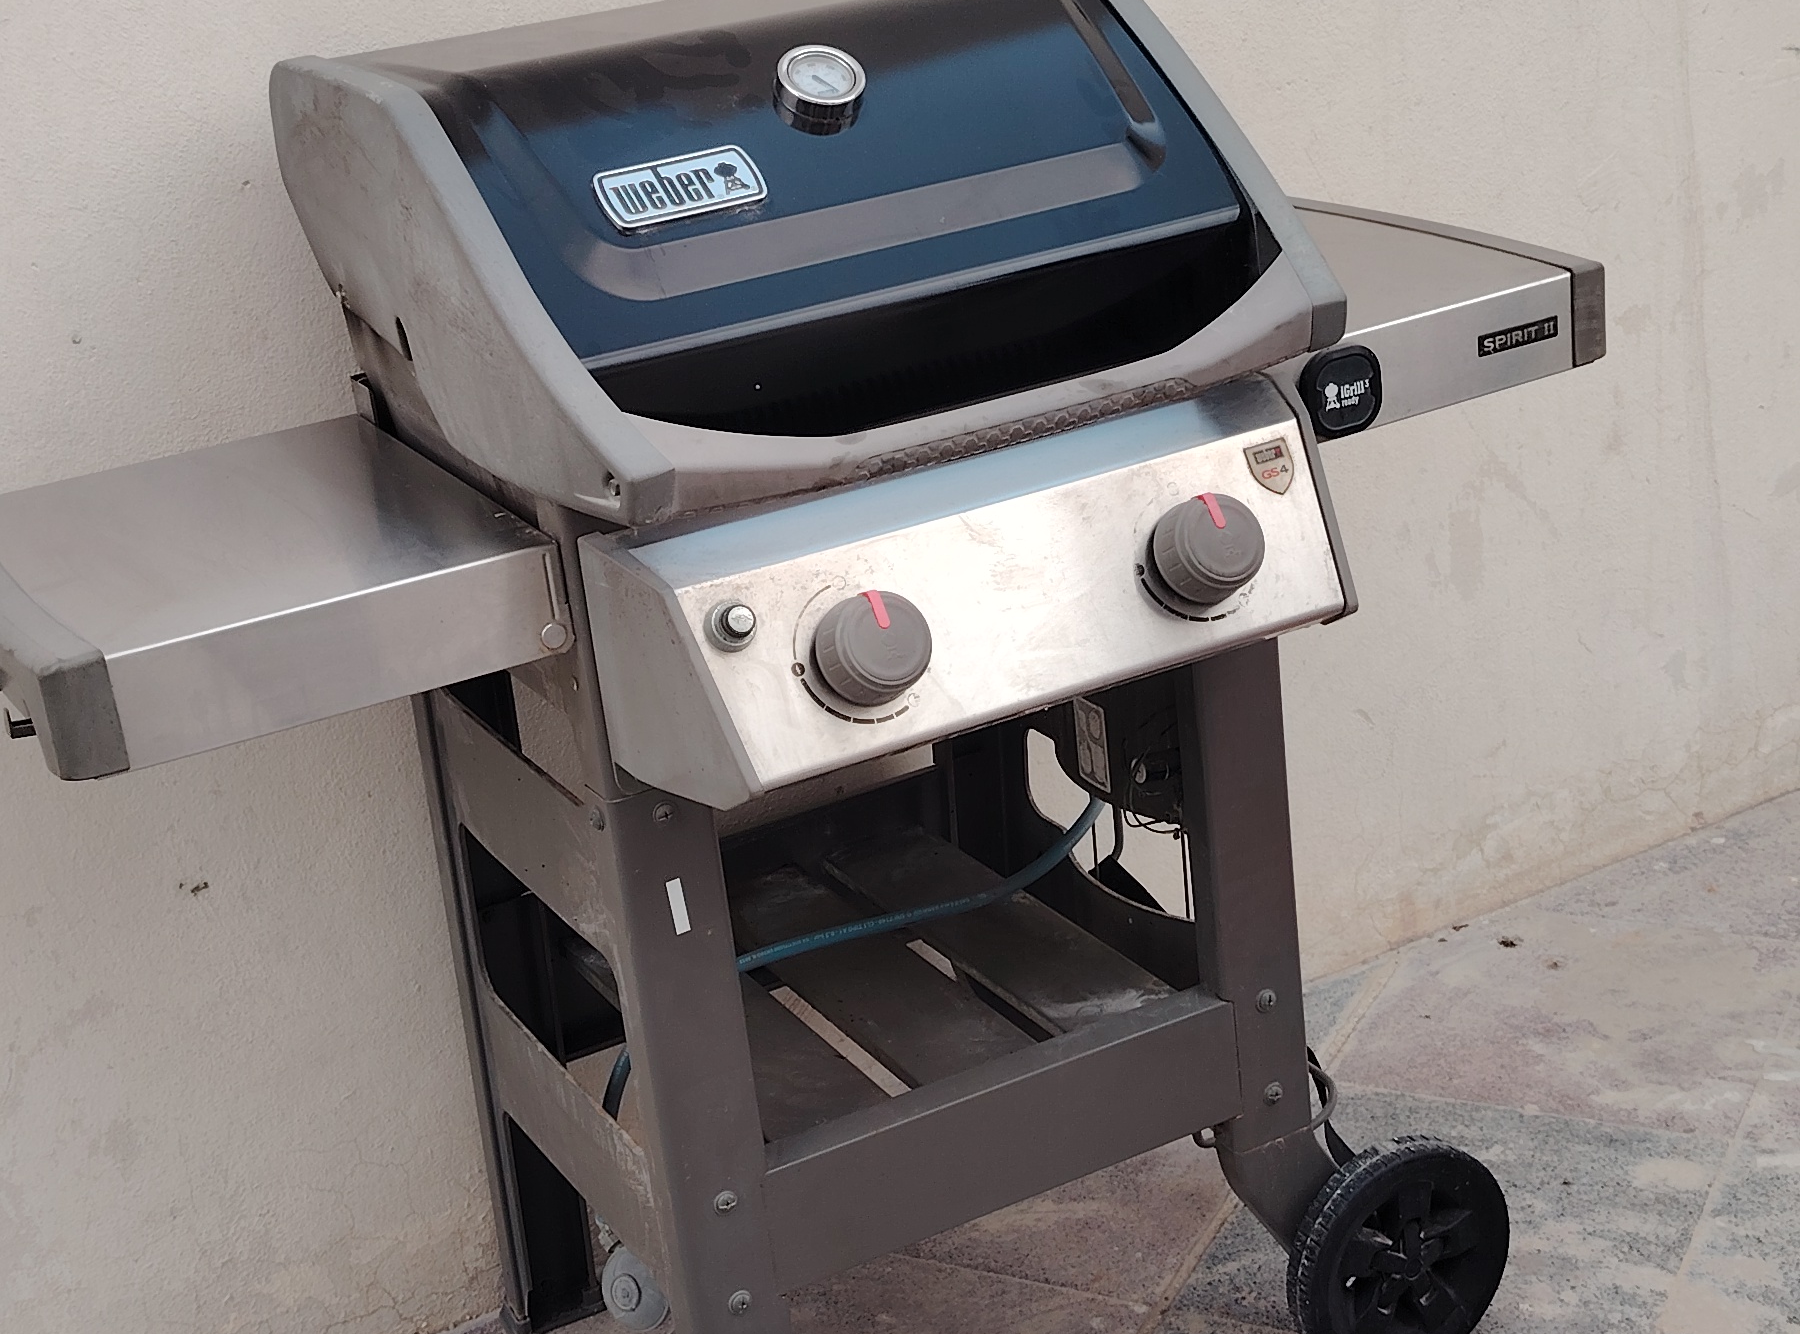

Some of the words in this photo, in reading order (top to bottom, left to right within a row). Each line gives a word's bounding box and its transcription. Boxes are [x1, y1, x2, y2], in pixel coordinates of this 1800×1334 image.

[608, 166, 715, 216] weber
[1483, 325, 1539, 352] SPIRIT
[1543, 321, 1555, 336] II
[1261, 464, 1290, 480] GS4
